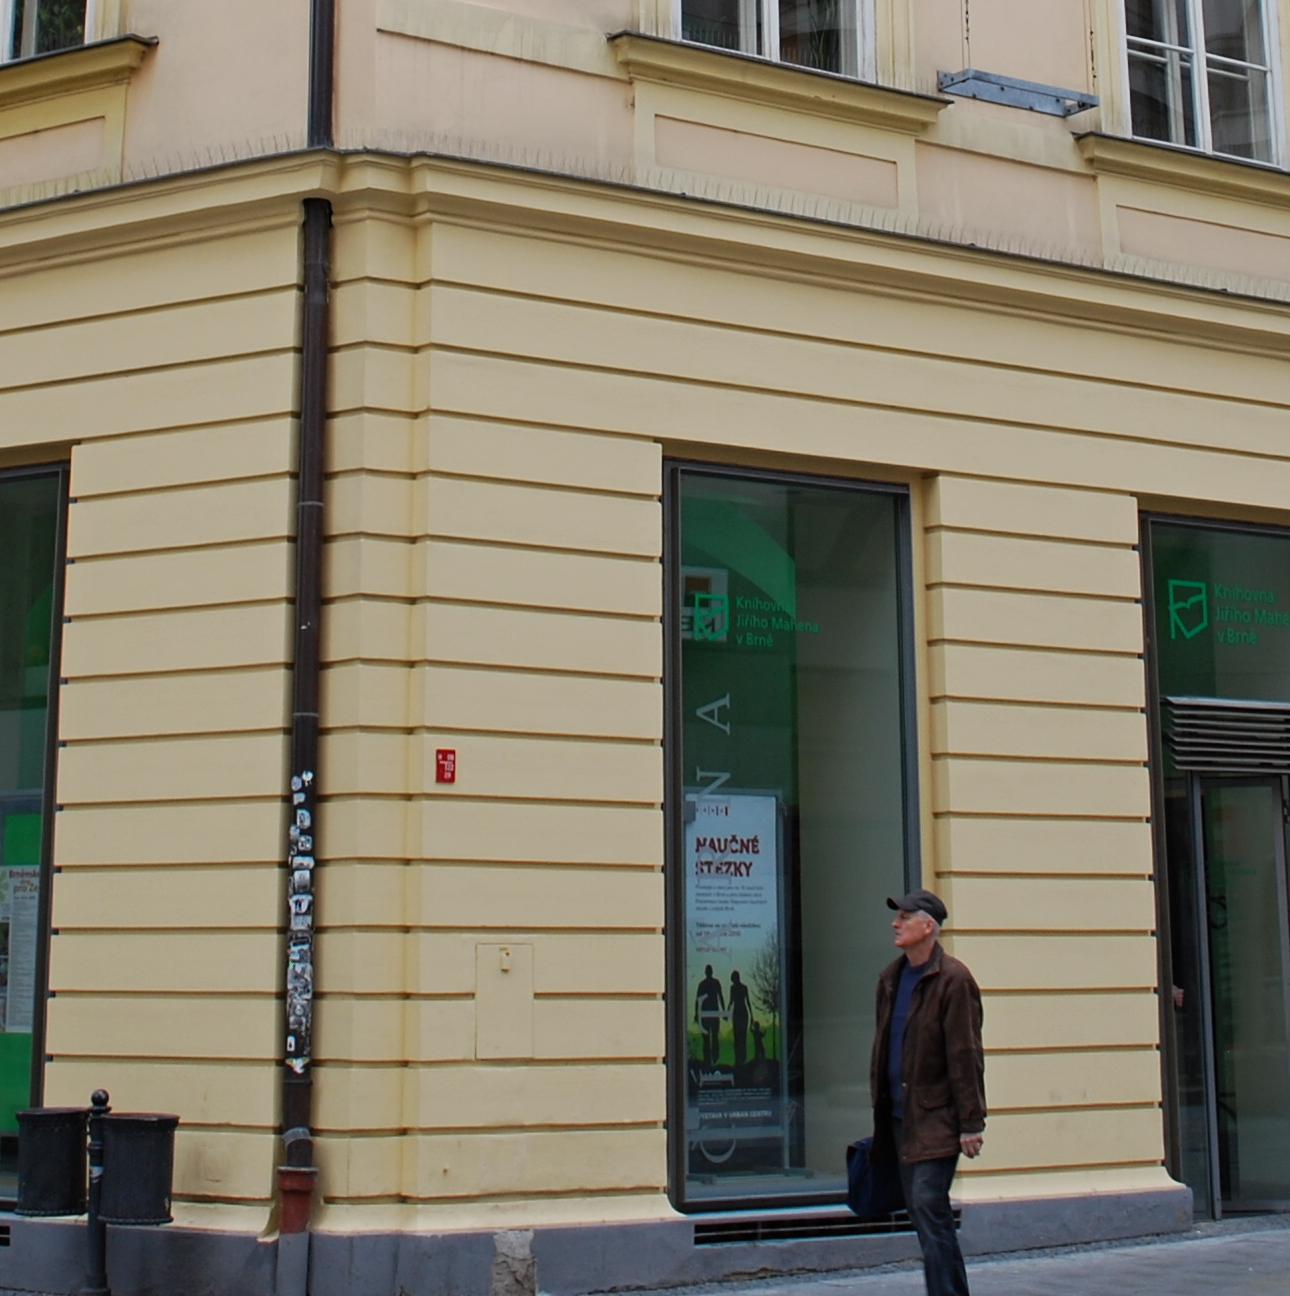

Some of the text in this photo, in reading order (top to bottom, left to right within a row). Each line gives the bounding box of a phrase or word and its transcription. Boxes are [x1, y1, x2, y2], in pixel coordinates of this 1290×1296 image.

[1214, 583, 1276, 604] Knihovna
[736, 613, 820, 634] Jiřího Mahena
[1216, 605, 1251, 624] Jiřího
[736, 632, 774, 647] v Brně
[695, 834, 760, 854] NAUČNÉ
[695, 861, 753, 877] STEZKY
